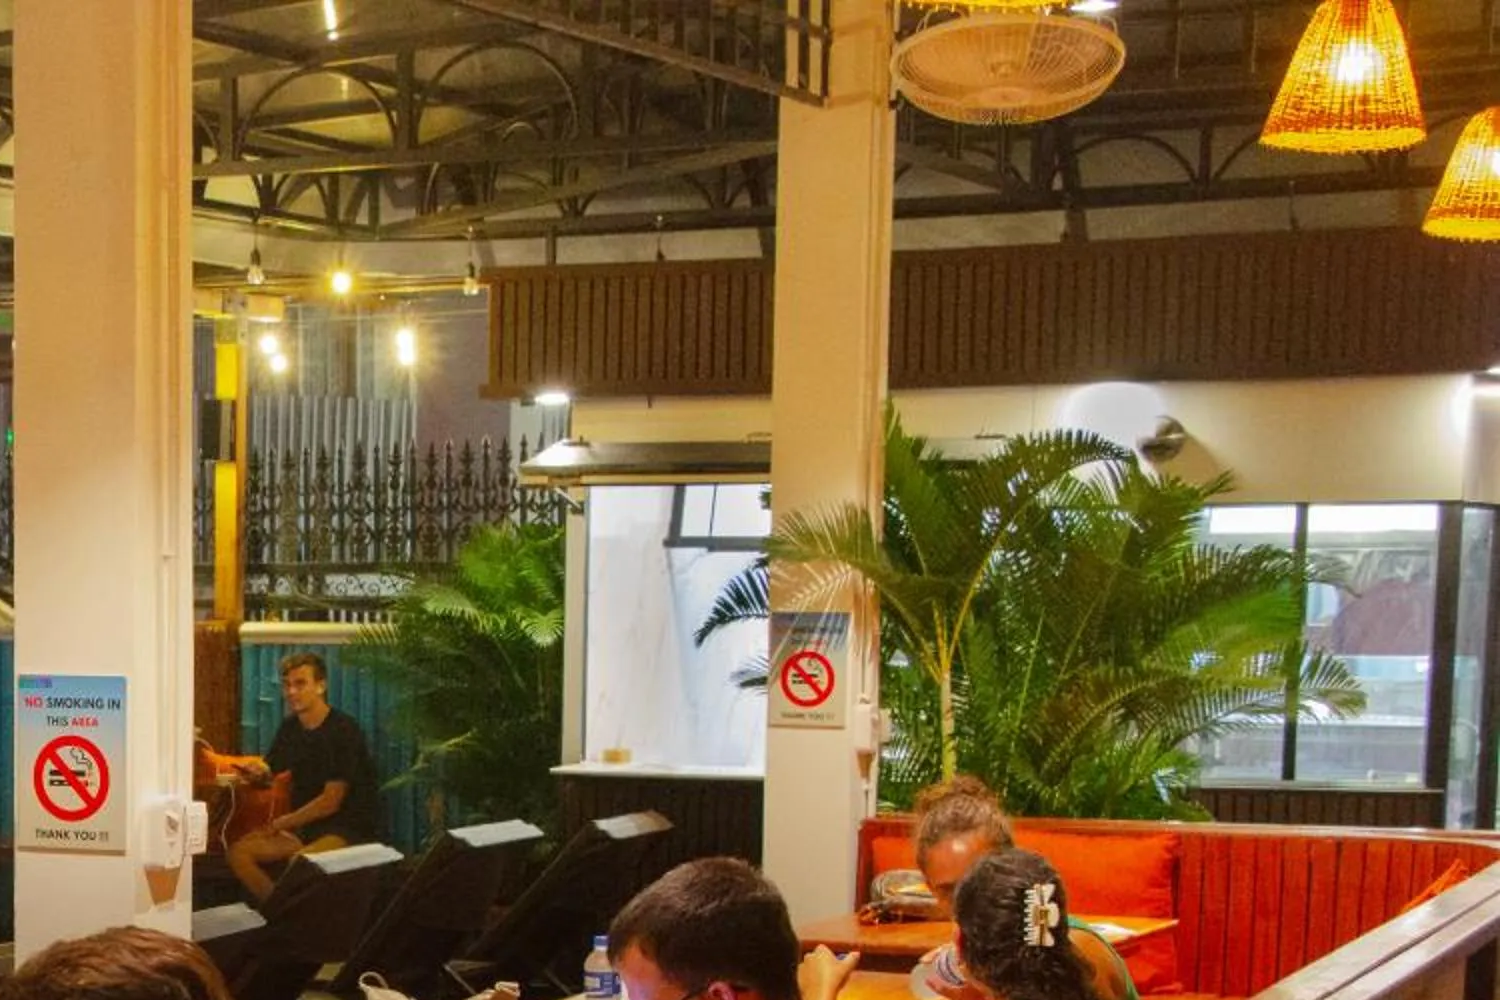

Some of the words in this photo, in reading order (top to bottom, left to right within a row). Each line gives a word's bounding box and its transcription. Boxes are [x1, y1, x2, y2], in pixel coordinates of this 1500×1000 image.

[24, 695, 44, 709] NO
[46, 697, 104, 709] SMOKING
[107, 698, 121, 710] IN
[46, 715, 69, 727] THIS
[71, 715, 99, 728] AREA
[35, 828, 70, 841] THANK
[73, 831, 97, 841] YOU
